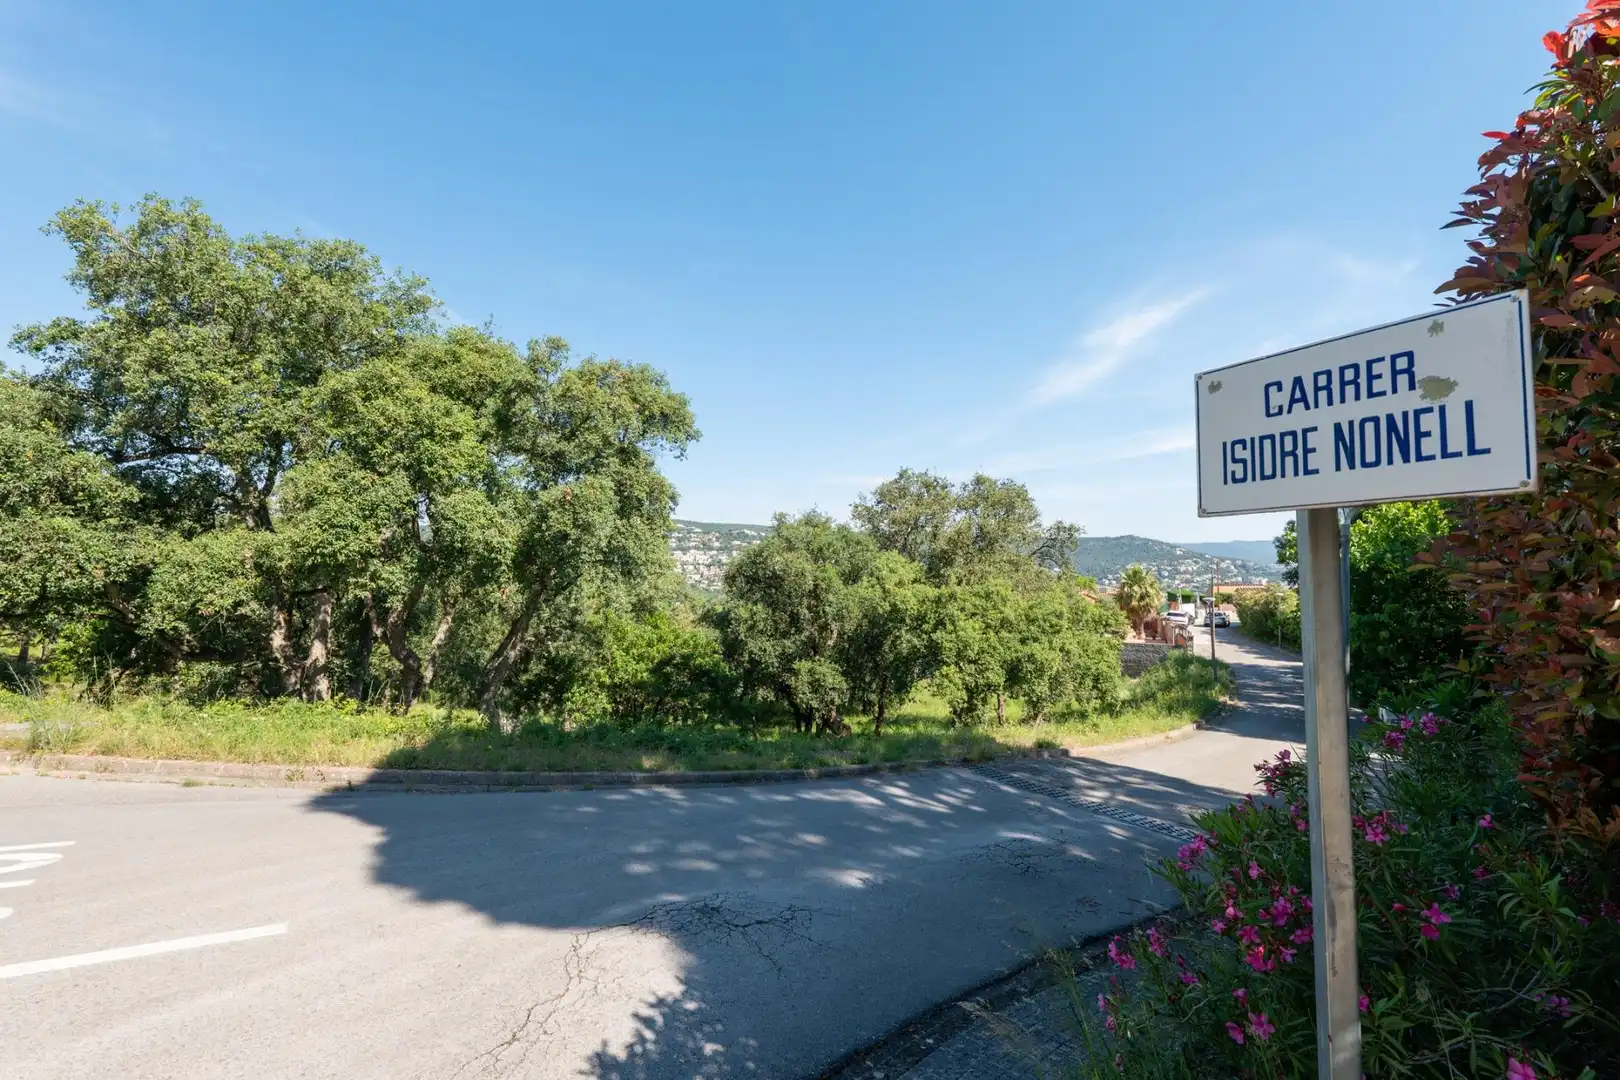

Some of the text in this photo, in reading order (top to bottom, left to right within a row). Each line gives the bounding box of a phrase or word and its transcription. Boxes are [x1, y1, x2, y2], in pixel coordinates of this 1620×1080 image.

[1264, 350, 1416, 418] CARRER
[1222, 400, 1491, 485] ISIDRE NONELL
